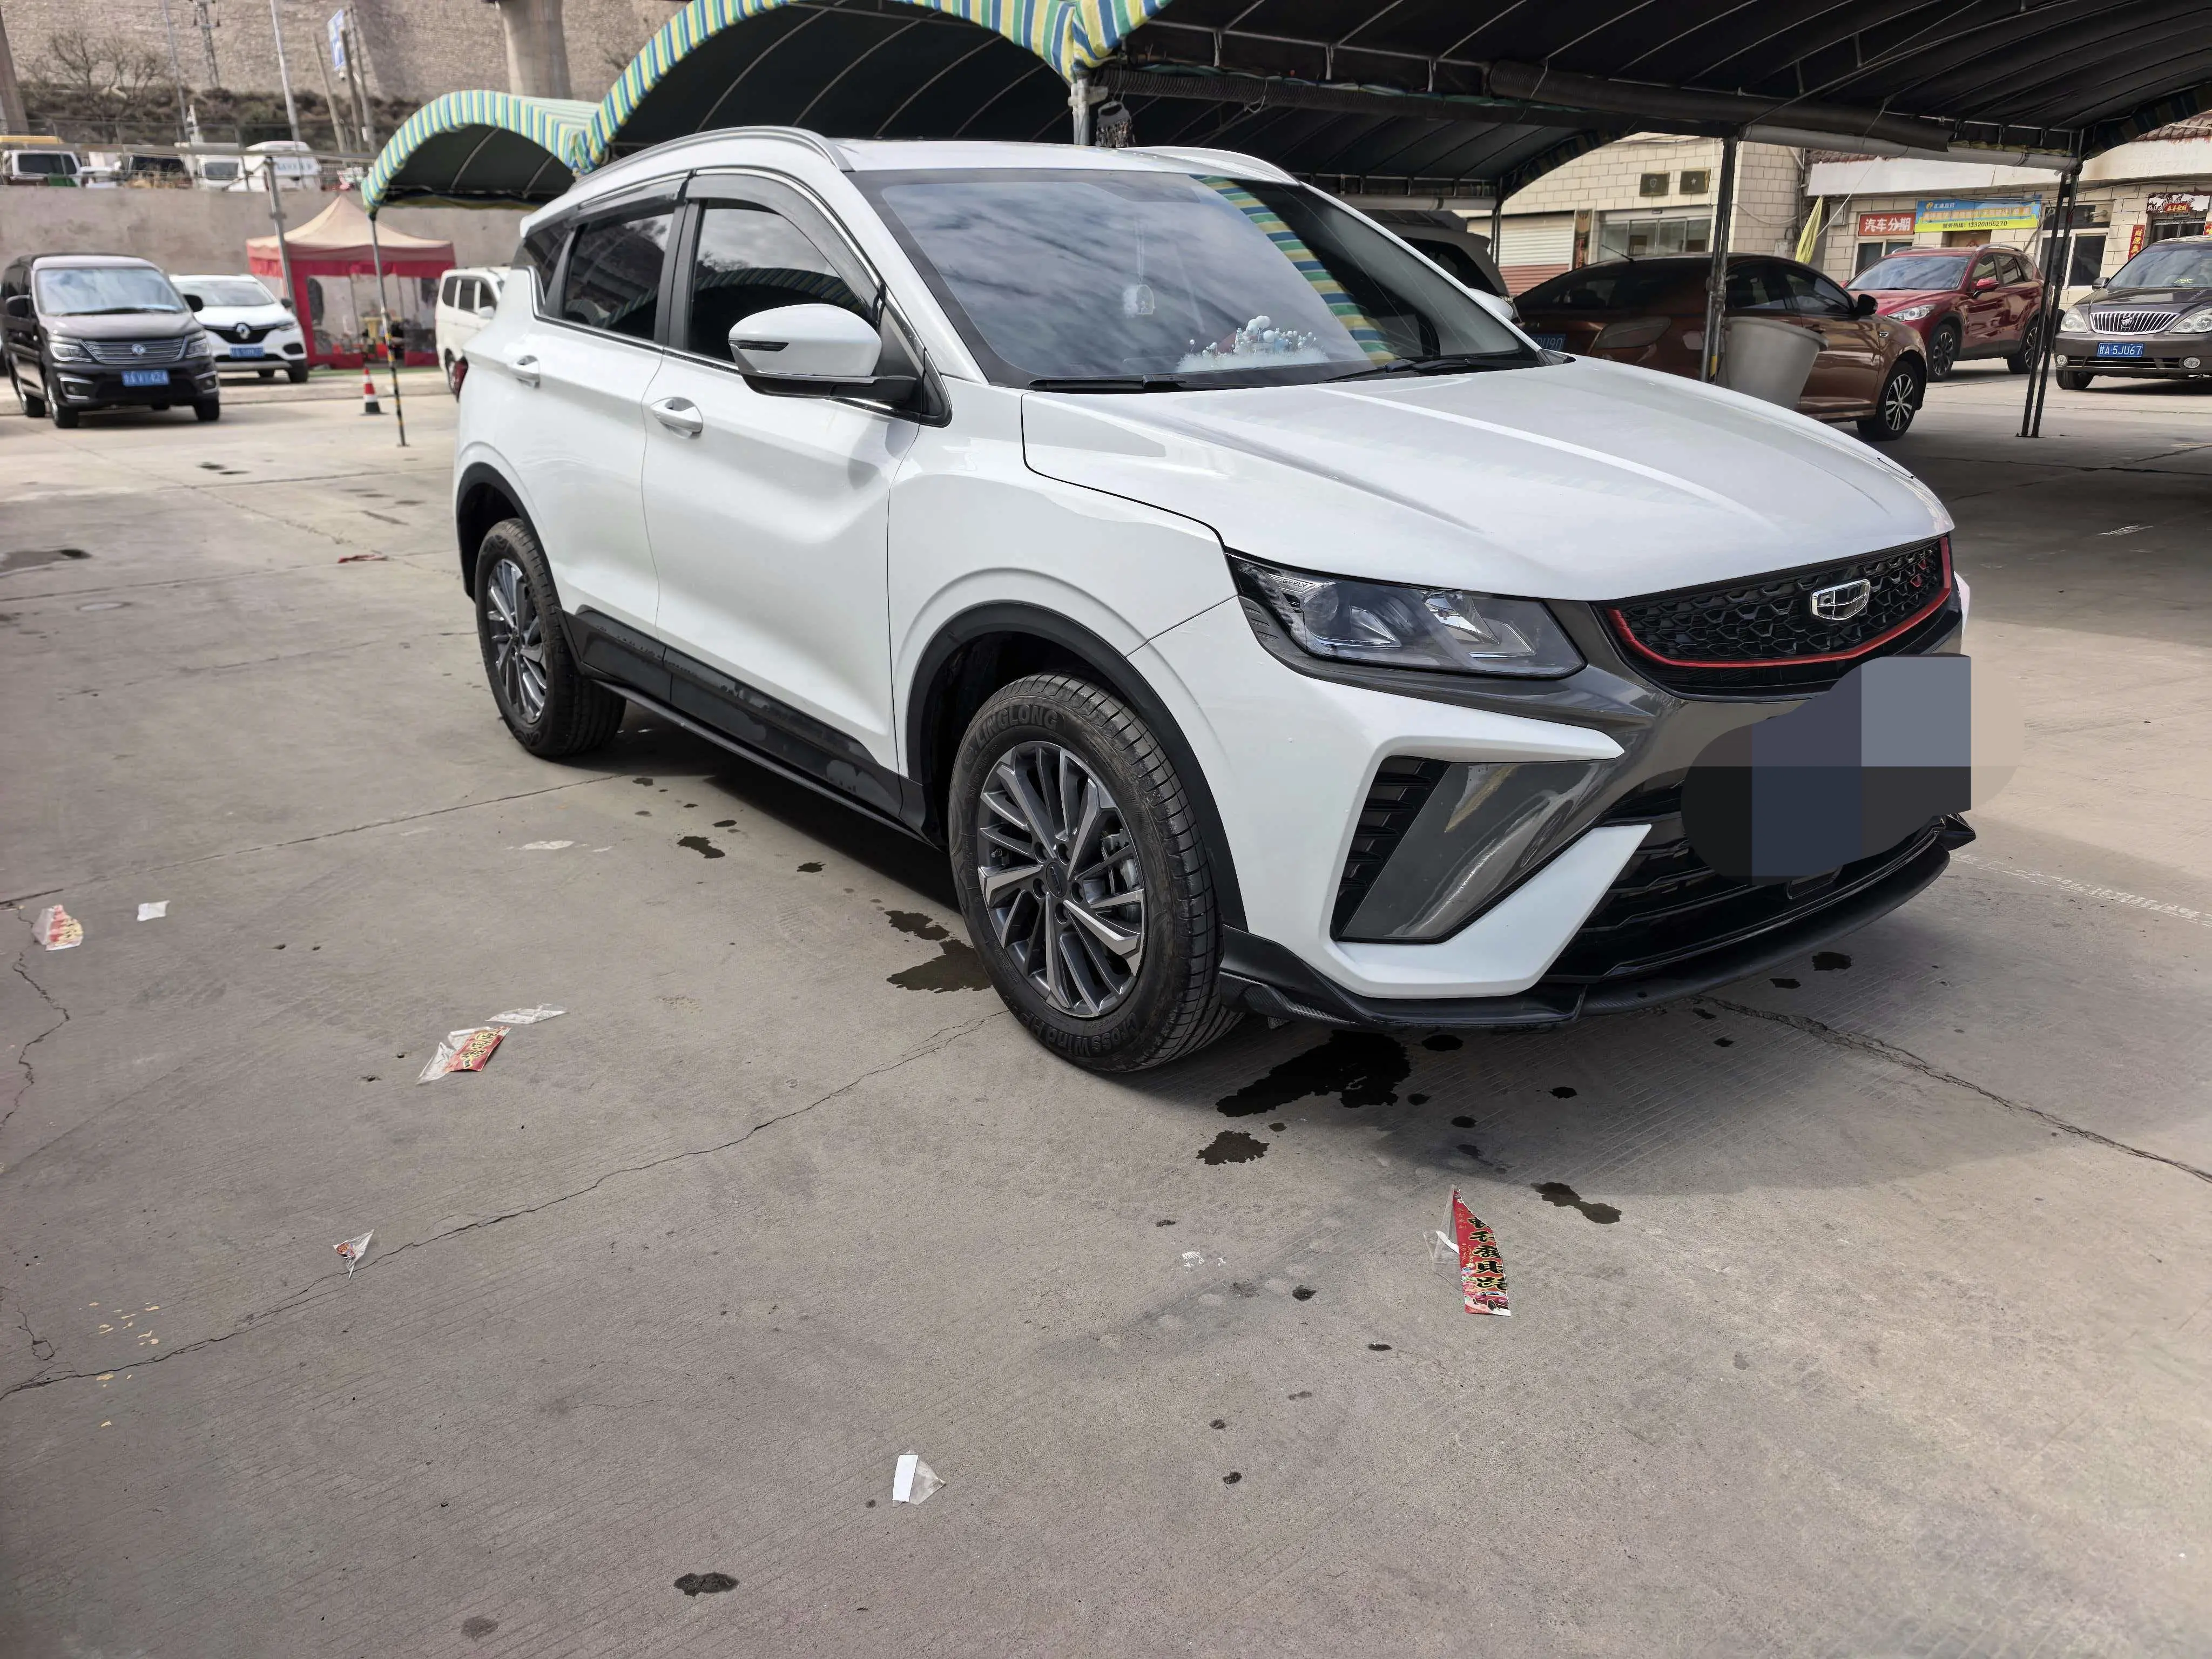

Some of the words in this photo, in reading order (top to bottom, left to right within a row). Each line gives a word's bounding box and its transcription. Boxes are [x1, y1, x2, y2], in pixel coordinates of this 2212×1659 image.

[1864, 217, 1911, 232] 汽车分期
[1283, 578, 1308, 588] GEELY
[975, 704, 1057, 748] LINGLONG
